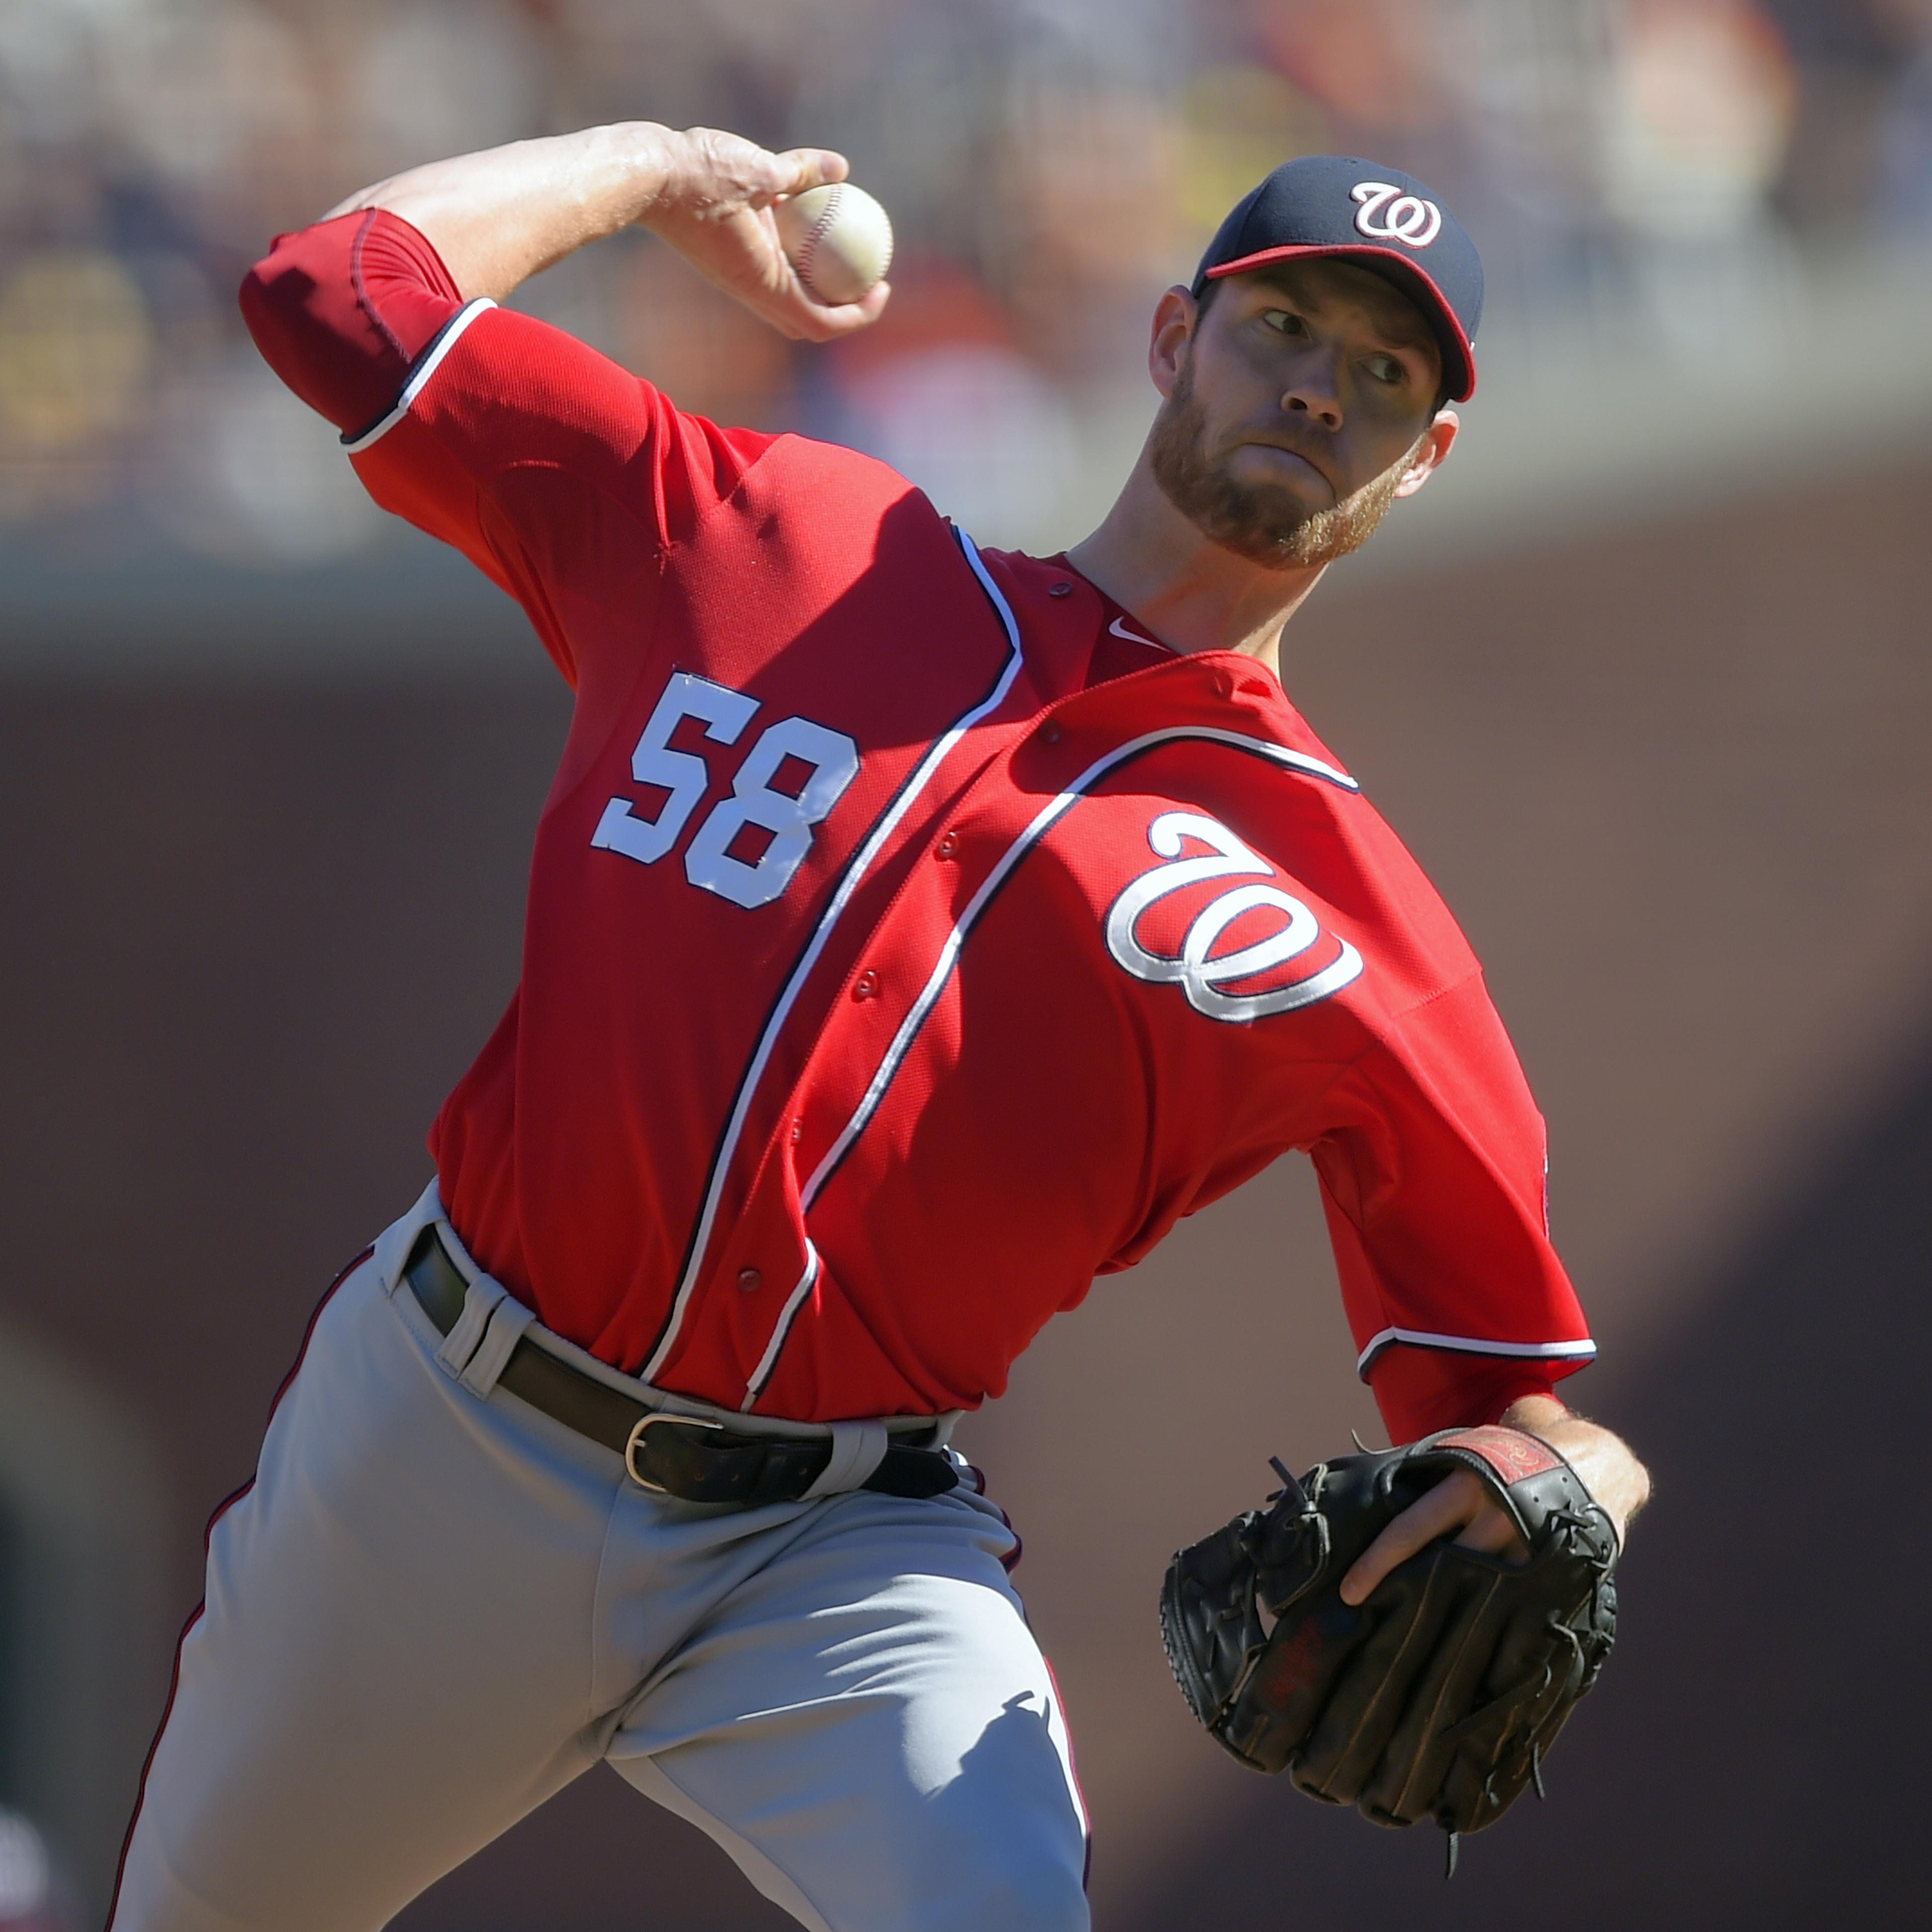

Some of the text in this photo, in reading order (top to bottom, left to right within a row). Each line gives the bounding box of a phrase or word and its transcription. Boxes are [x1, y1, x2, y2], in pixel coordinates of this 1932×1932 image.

[1350, 181, 1441, 249] W
[590, 671, 861, 910] 58
[1104, 811, 1364, 1023] W
